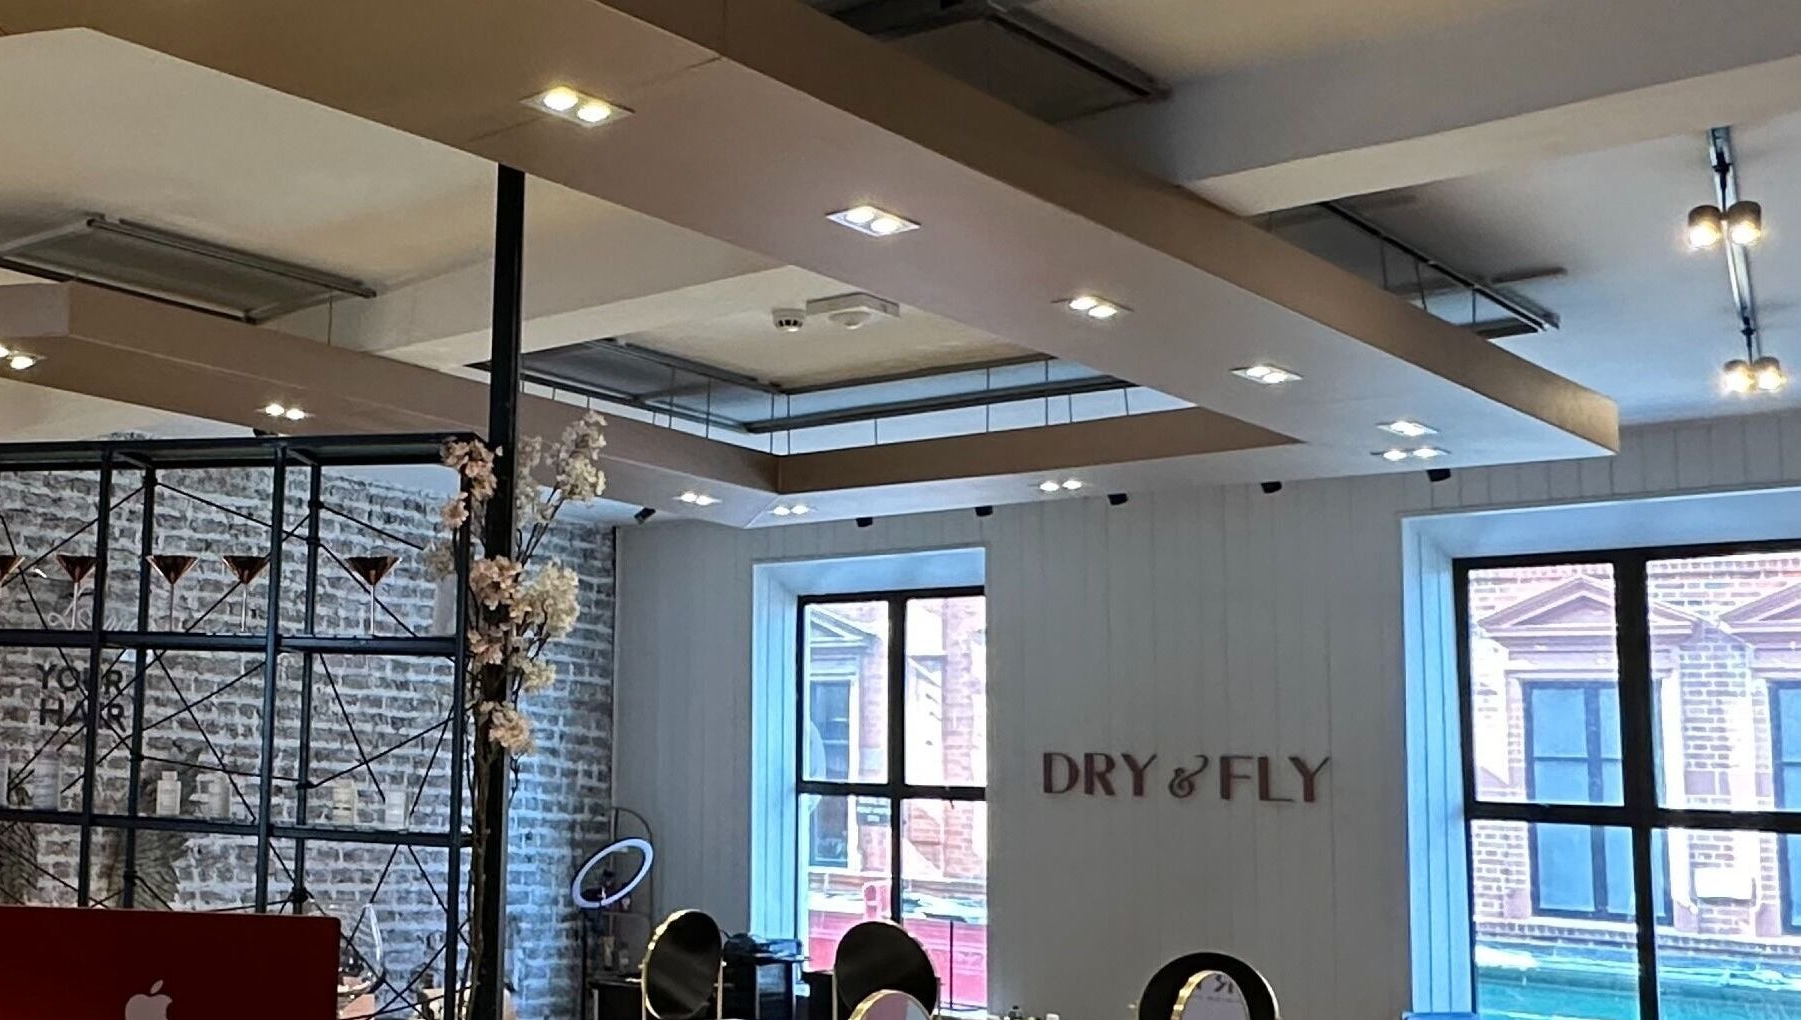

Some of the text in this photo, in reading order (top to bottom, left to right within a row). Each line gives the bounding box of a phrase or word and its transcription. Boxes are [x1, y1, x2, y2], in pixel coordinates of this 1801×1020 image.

[37, 662, 124, 694] YOR
[1041, 751, 1331, 804] DRY & FLY
